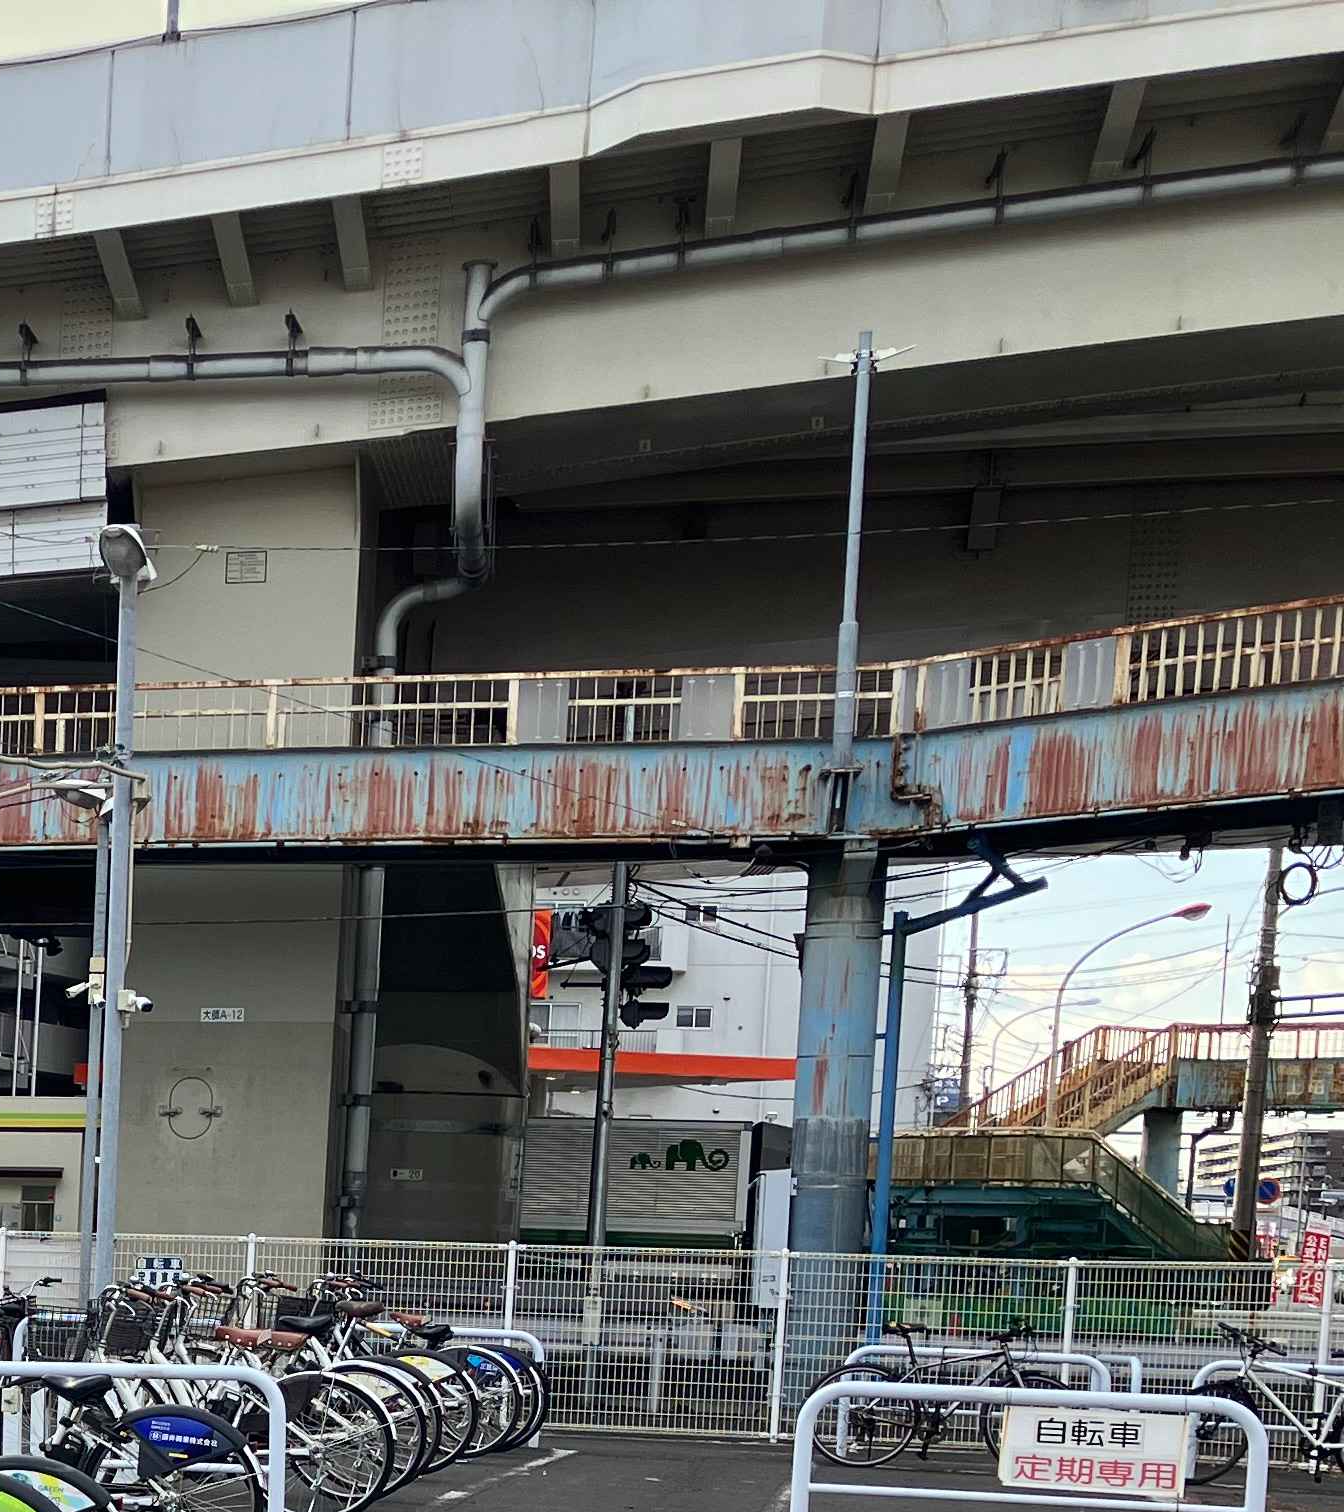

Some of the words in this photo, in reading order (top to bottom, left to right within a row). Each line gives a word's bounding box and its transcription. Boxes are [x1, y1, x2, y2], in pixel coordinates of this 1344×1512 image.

[1036, 1417, 1142, 1448] 自転車
[1014, 1454, 1178, 1490] 定期専用
